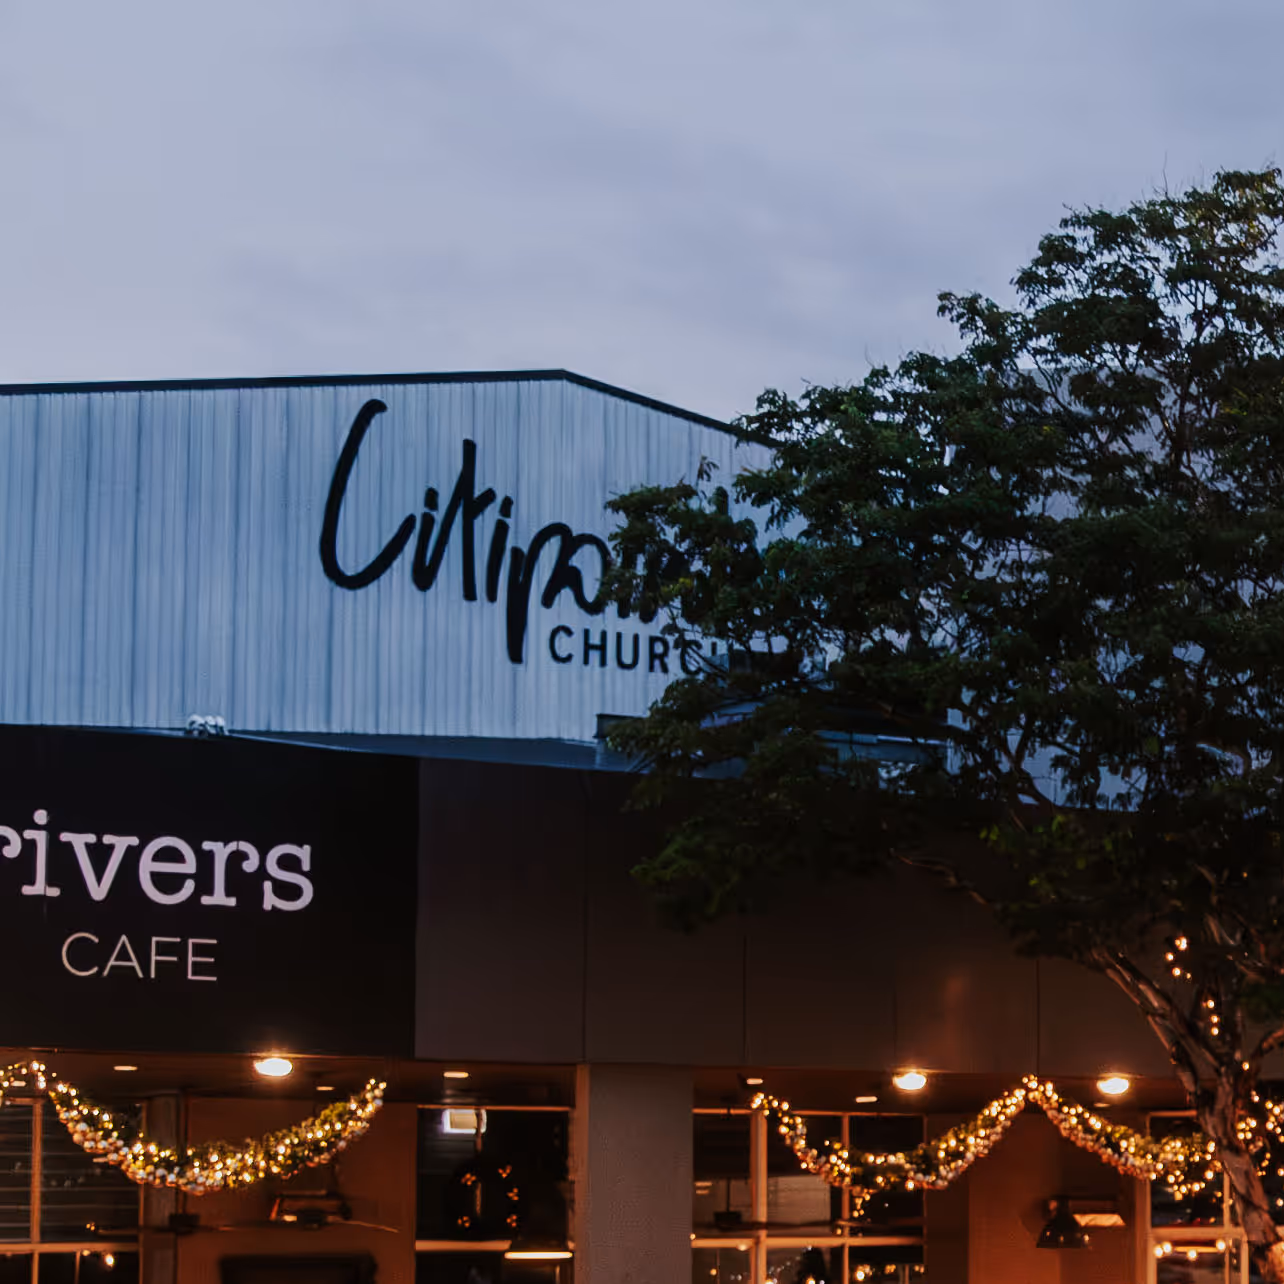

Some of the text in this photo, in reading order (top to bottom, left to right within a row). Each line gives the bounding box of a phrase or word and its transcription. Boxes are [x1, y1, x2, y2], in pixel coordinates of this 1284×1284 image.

[319, 398, 700, 664] Citipo
[548, 625, 718, 676] CHURC
[61, 931, 218, 980] CAFE
